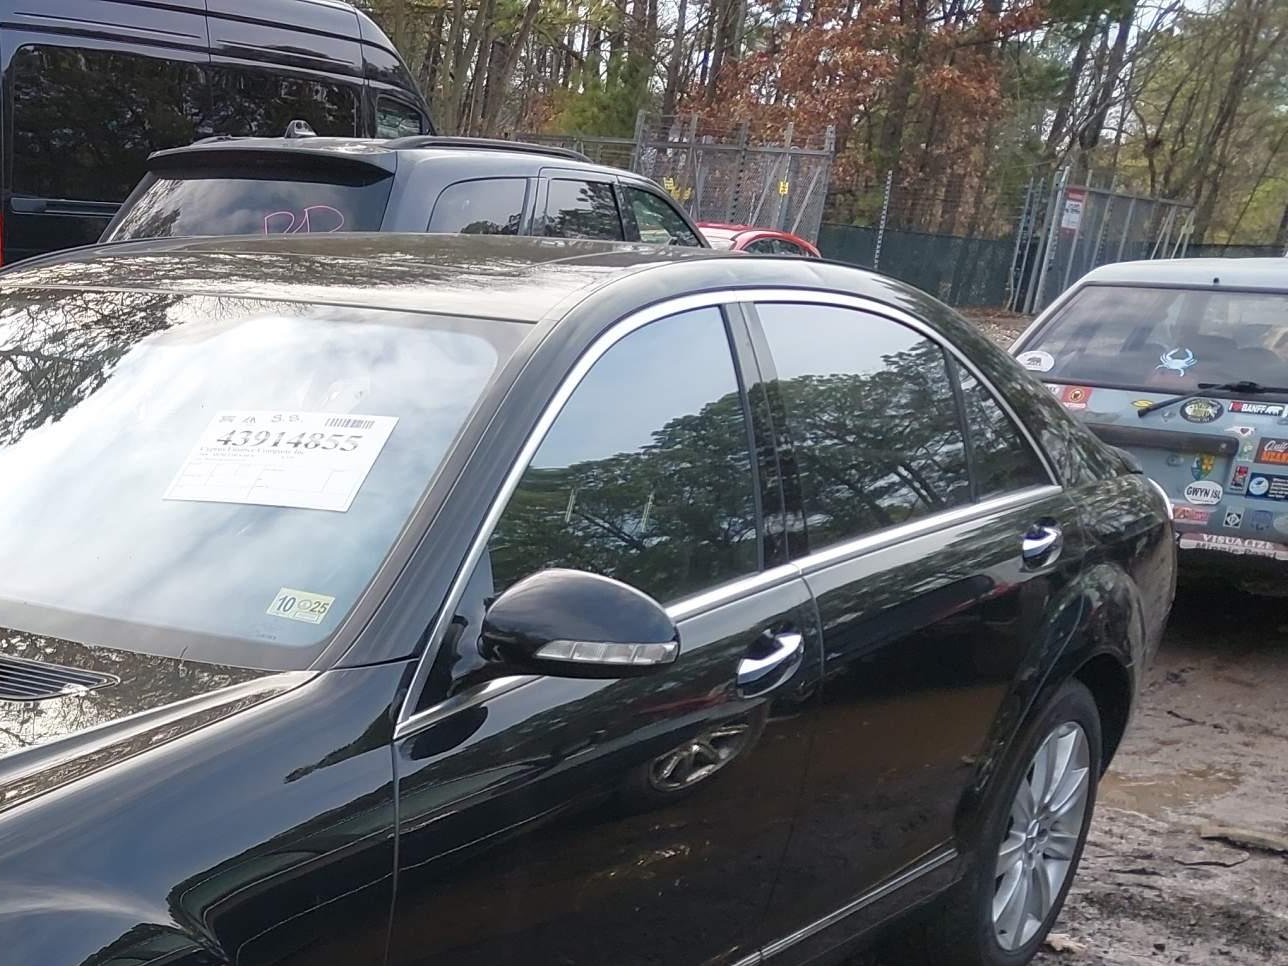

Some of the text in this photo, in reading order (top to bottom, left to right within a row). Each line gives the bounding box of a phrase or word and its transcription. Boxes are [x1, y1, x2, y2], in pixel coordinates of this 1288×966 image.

[1241, 403, 1266, 413] BANFF
[216, 429, 363, 452] 43914855
[1186, 486, 1220, 499] GWYN ISL
[1200, 533, 1274, 549] VISUALIZE
[276, 595, 297, 613] 10
[309, 601, 330, 615] 25
